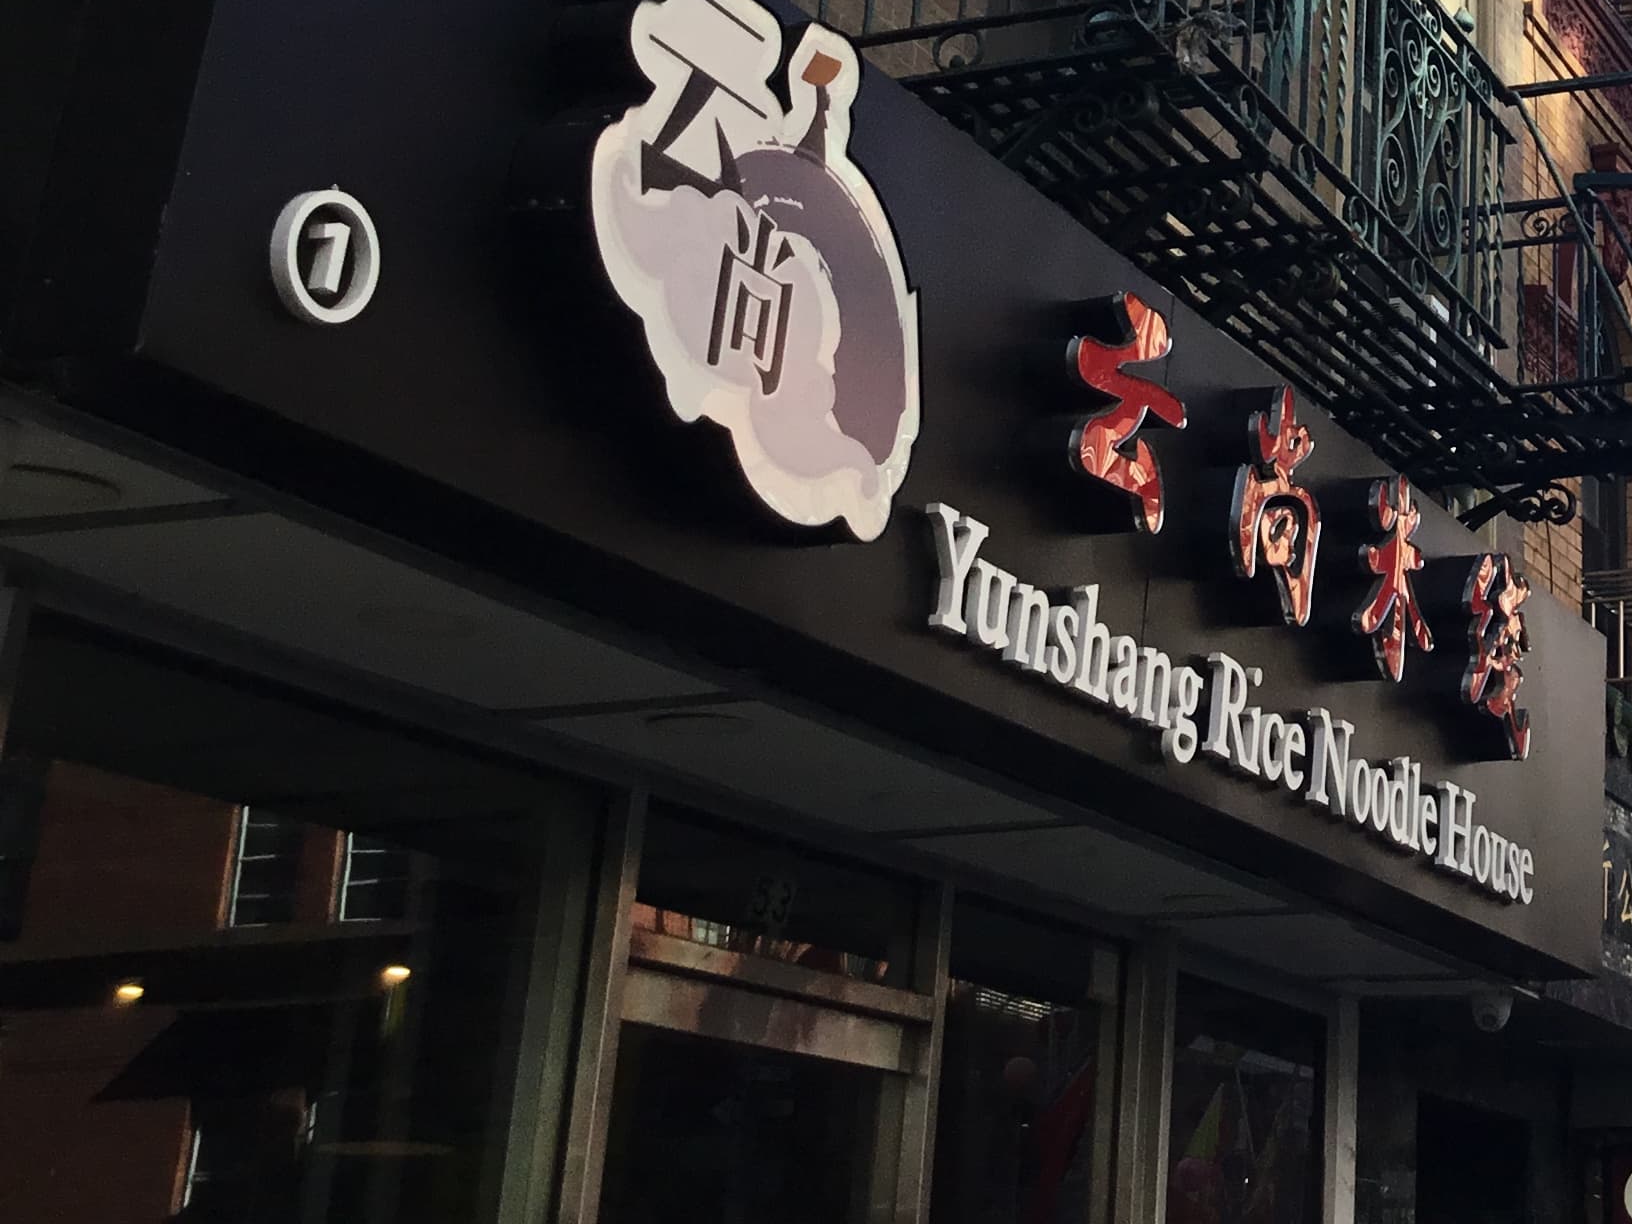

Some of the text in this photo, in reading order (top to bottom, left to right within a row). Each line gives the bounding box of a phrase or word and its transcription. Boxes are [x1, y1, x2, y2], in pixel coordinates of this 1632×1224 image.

[925, 502, 1534, 906] Yunshang Rice Noodle House
